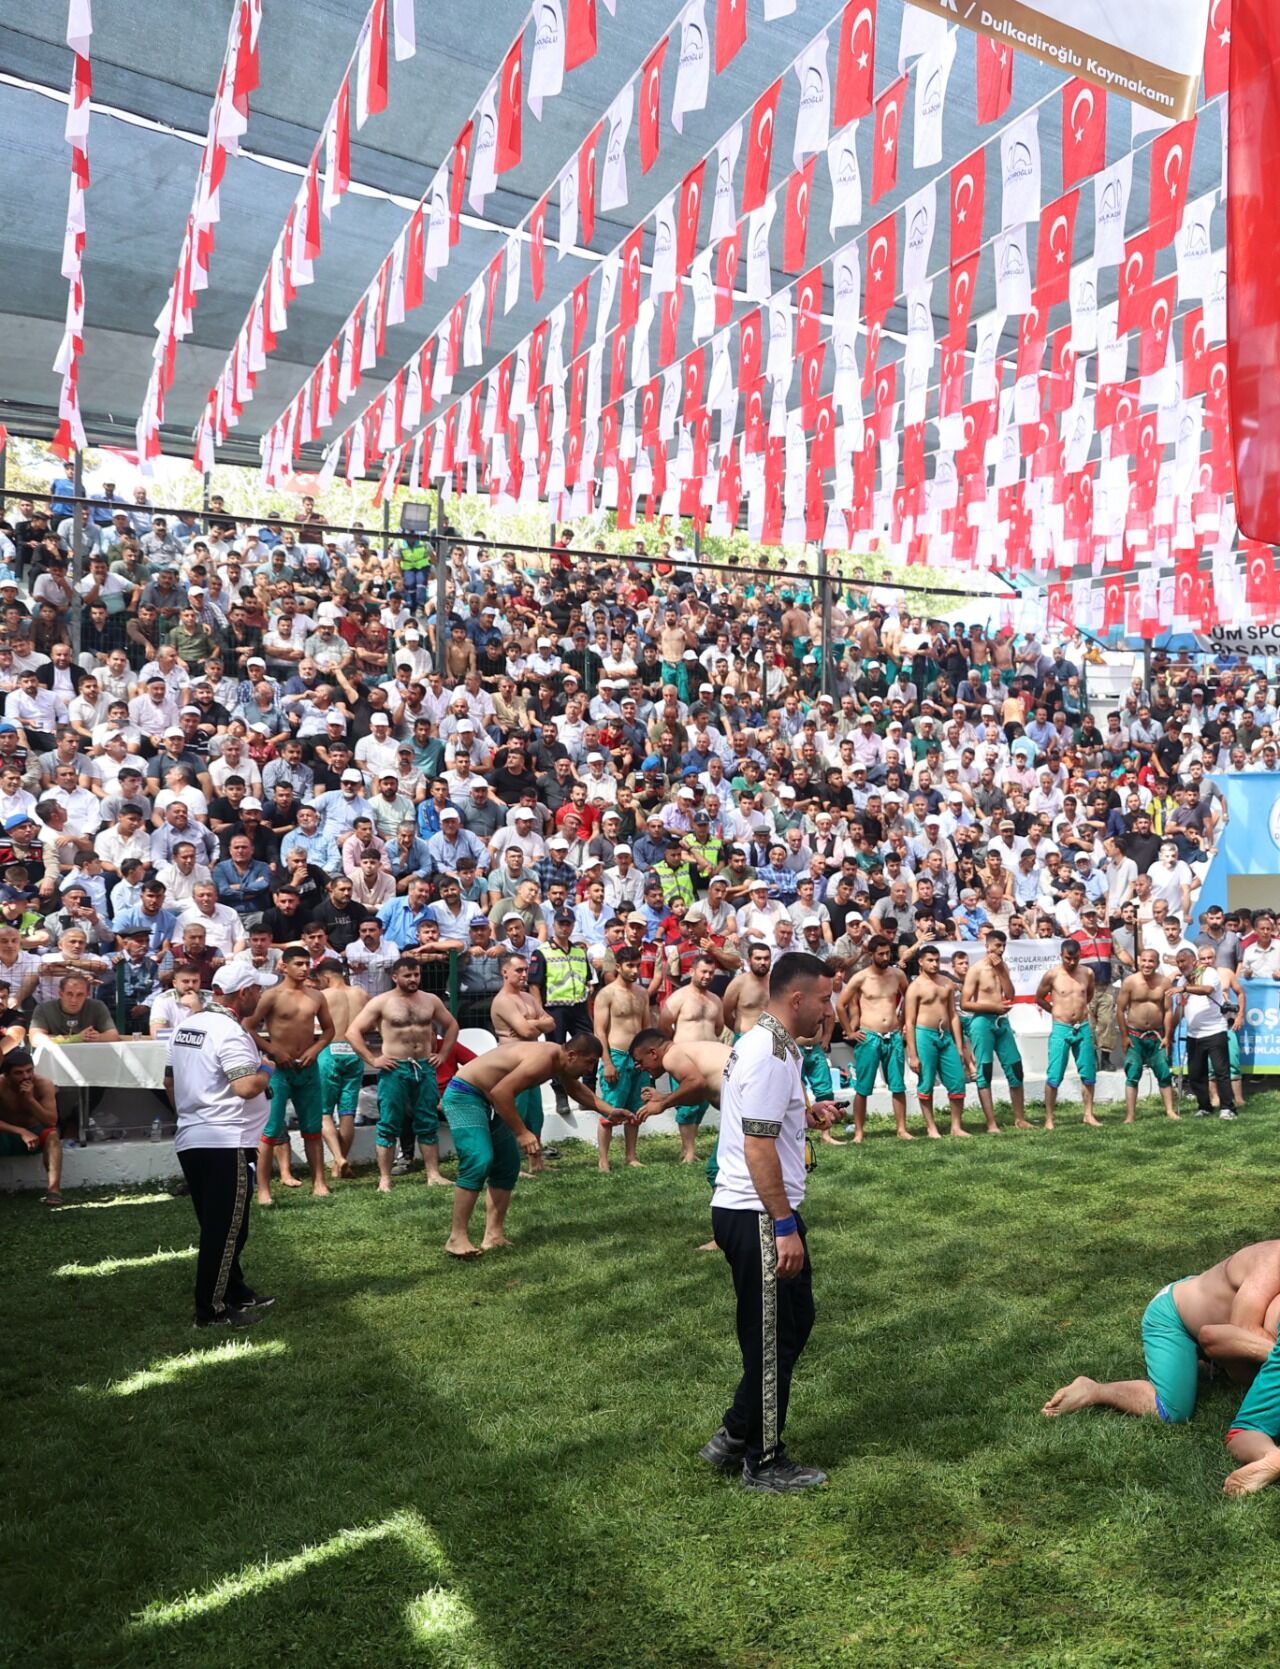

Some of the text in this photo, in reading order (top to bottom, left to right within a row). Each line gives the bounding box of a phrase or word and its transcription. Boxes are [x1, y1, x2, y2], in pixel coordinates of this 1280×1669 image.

[980, 10, 1082, 67] Dulkadiroğlu
[1086, 57, 1174, 107] Kaymakamı
[1209, 624, 1243, 640] ÜM
